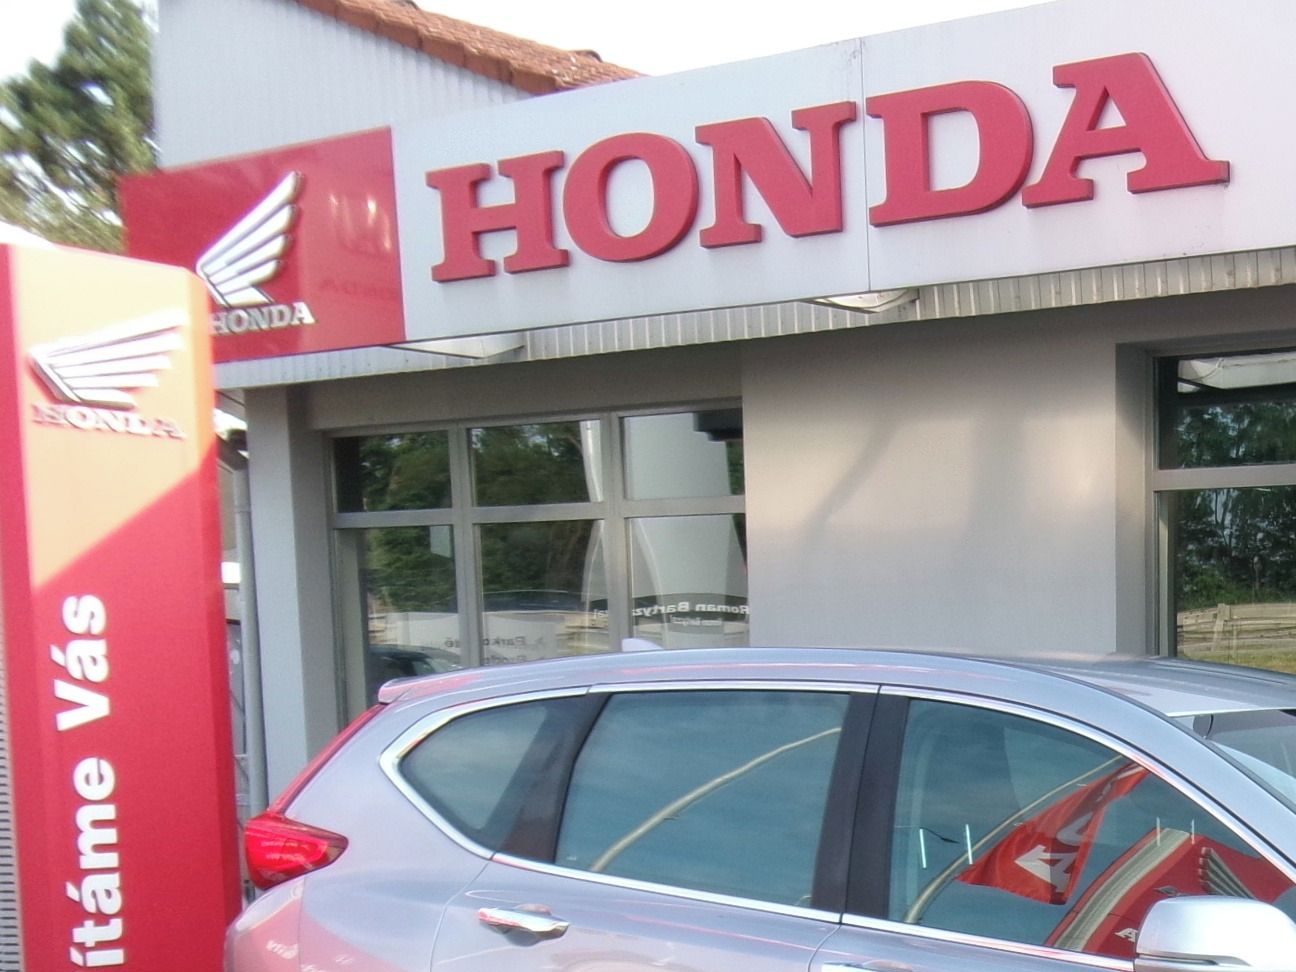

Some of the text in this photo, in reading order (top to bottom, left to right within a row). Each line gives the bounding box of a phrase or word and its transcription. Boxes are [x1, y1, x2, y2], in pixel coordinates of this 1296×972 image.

[426, 52, 1230, 283] HONDA
[209, 302, 317, 335] HONDA
[31, 402, 187, 440] HONDA
[54, 594, 111, 731] Vás
